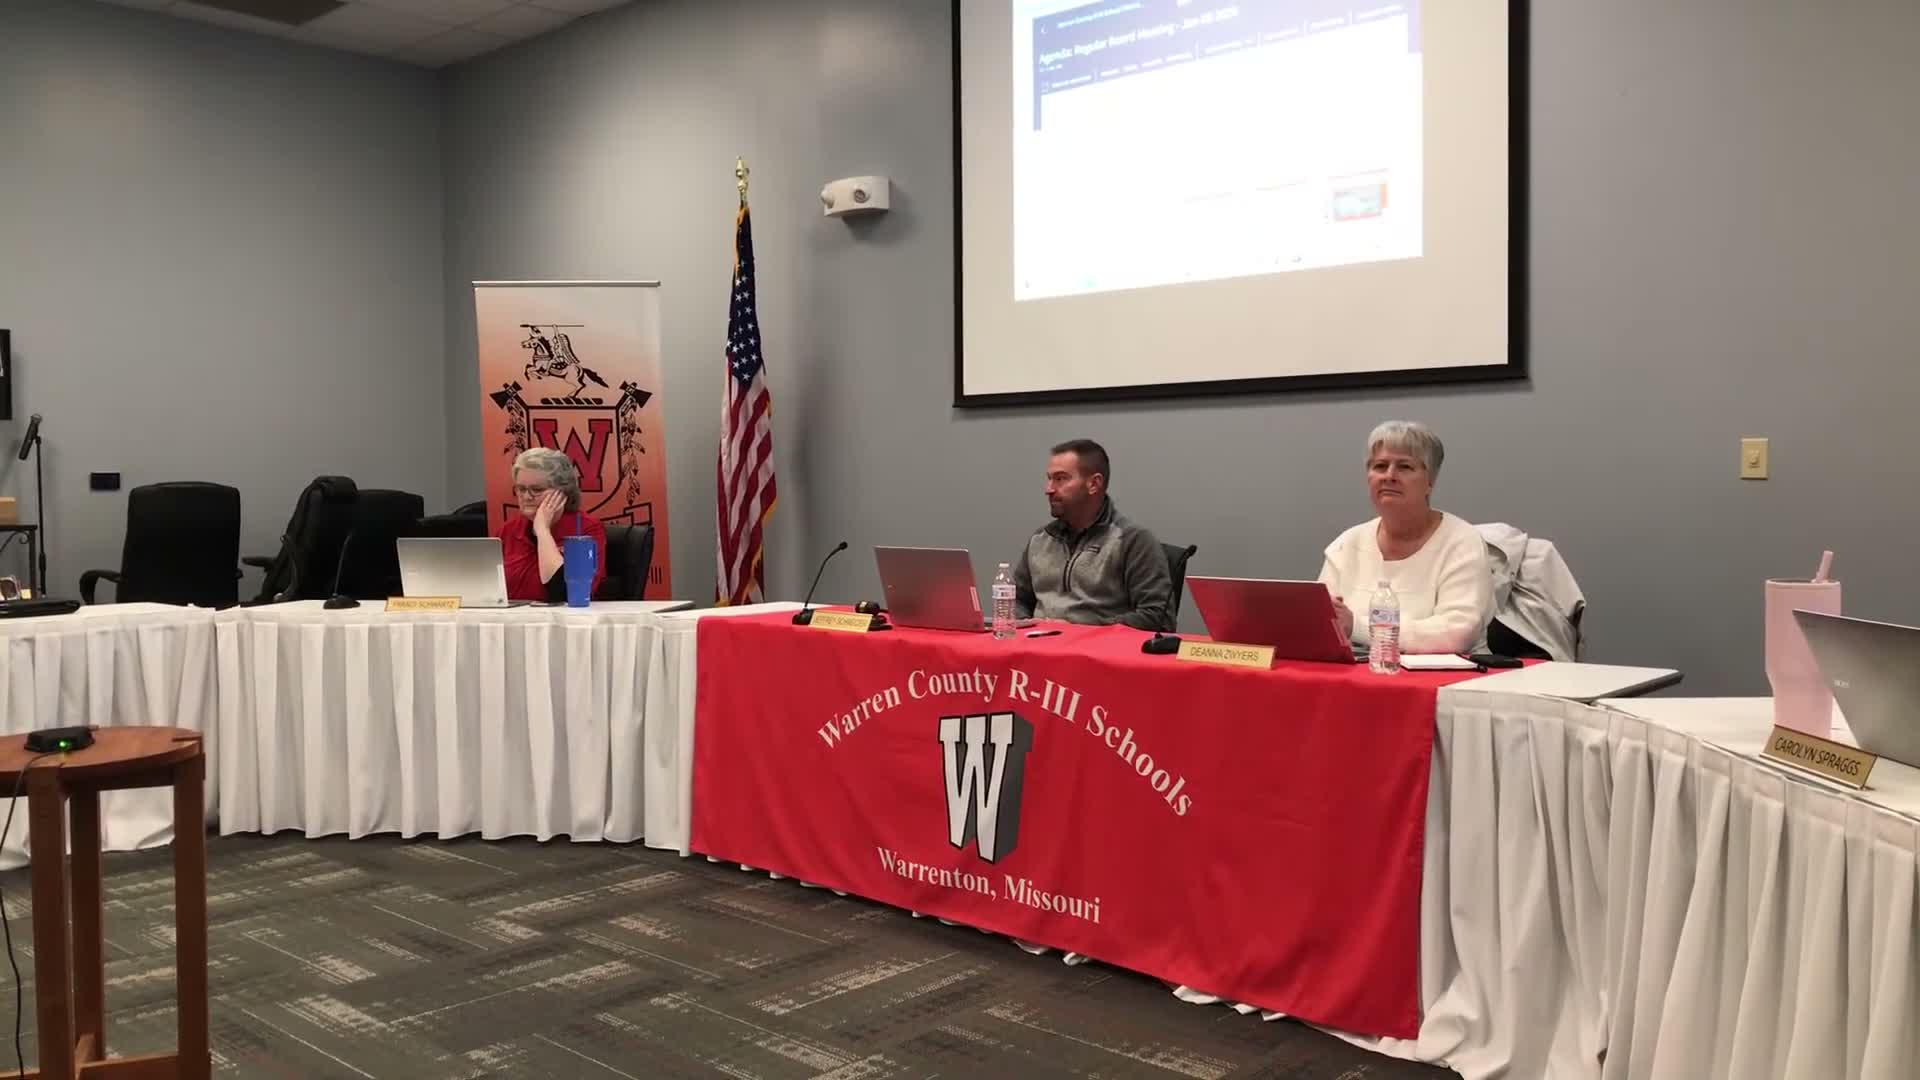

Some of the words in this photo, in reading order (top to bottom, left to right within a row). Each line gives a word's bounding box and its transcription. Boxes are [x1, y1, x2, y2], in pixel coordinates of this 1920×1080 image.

[1074, 40, 1107, 56] Regular
[1108, 31, 1136, 47] Board
[1190, 646, 1223, 659] DEANNA
[1223, 649, 1259, 662] ZWYERS
[817, 686, 901, 750] Warren
[908, 666, 998, 702] County
[1008, 668, 1082, 723] R-III
[1085, 705, 1193, 816] Schools
[1775, 737, 1818, 762] CAROLYN
[1815, 750, 1861, 776] SPRAGGS
[938, 711, 1034, 864] W
[876, 846, 997, 900] Warrenton,
[1003, 874, 1100, 924] Missouri
